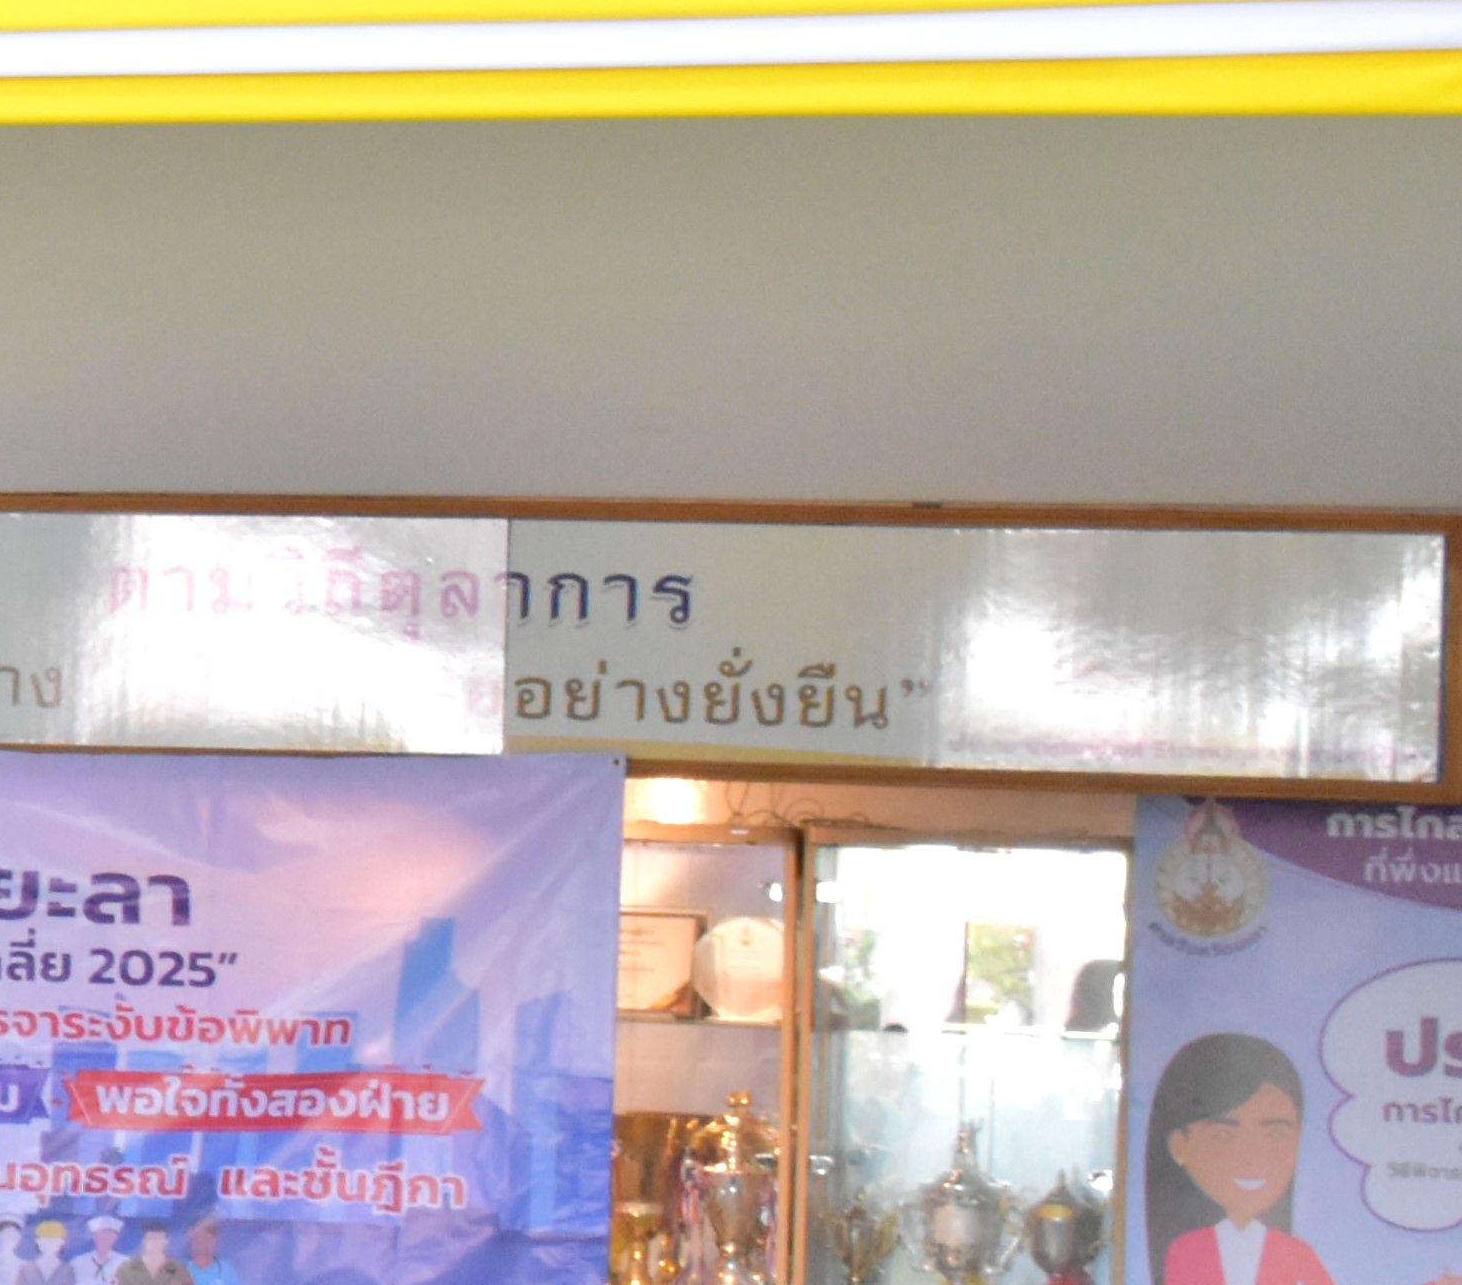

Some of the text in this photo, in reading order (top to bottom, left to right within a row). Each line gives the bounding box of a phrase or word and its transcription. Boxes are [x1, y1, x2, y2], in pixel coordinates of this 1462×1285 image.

[465, 648, 933, 732] อย่างยั่งยืน”
[96, 1069, 450, 1123] พอใจทั้งสองฝ่าย
[219, 1146, 468, 1214] และชั้นฎีกา
